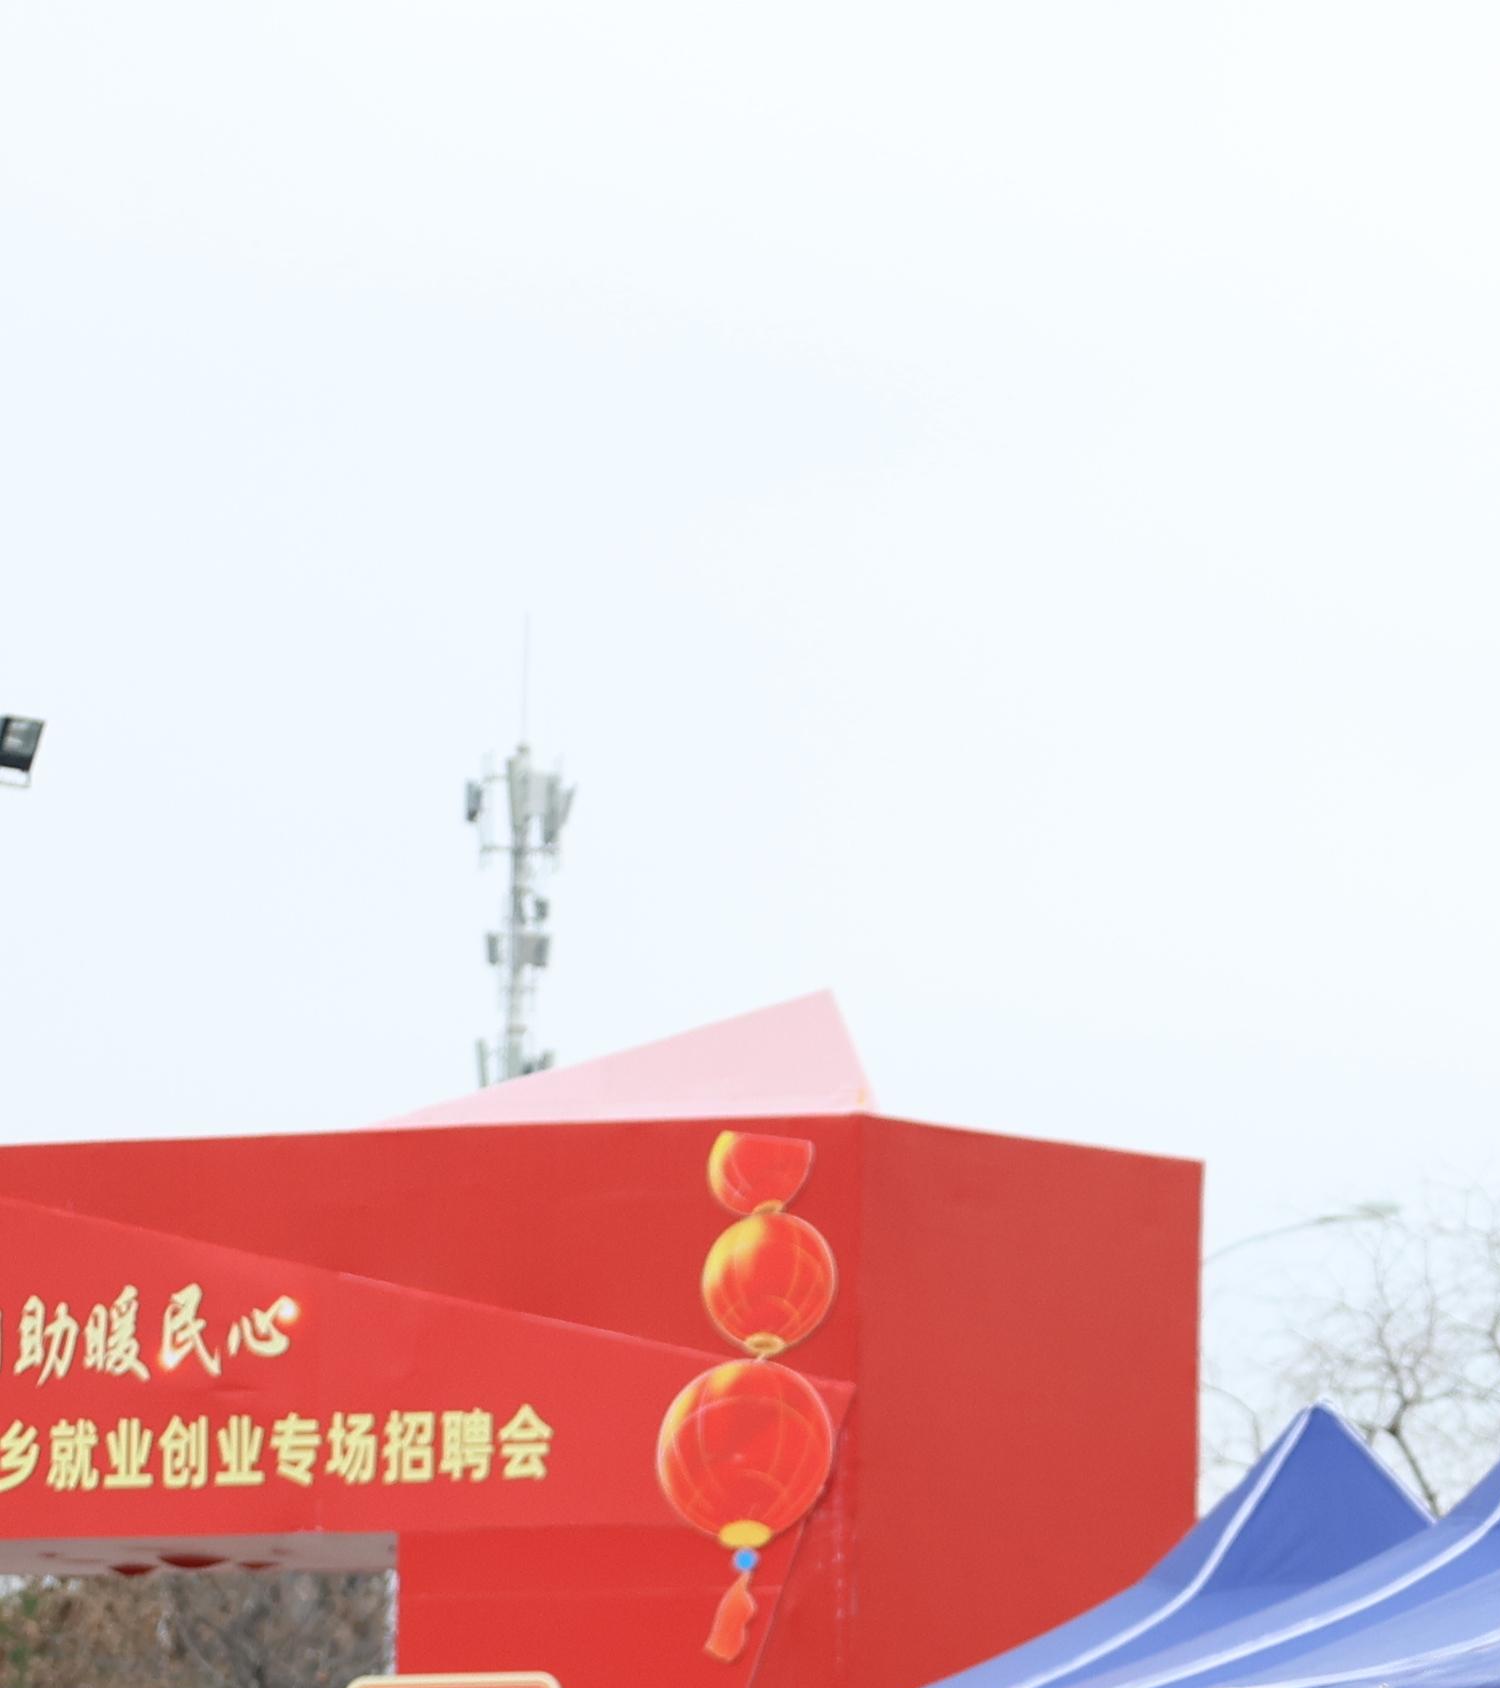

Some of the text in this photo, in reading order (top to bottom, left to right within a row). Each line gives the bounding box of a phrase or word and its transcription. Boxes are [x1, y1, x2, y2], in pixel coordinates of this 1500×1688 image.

[0, 1283, 299, 1387] 助暖民心
[0, 1403, 554, 1492] 乡就业创业专场招聘会
